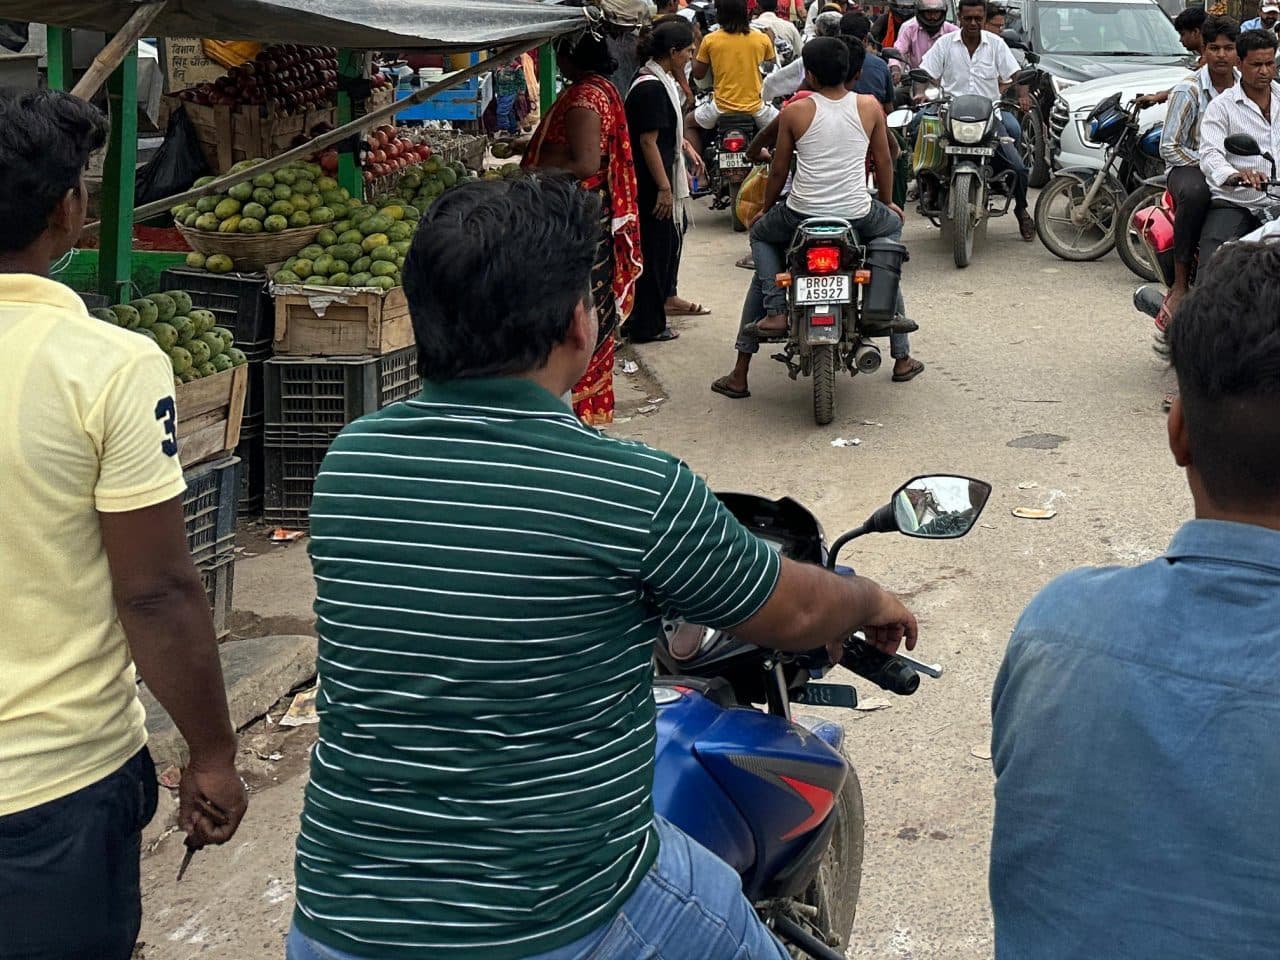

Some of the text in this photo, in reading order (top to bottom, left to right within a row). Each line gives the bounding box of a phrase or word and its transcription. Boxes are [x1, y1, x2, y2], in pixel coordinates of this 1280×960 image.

[806, 277, 843, 289] BR07B
[806, 288, 843, 300] A5927
[155, 395, 178, 457] 3
